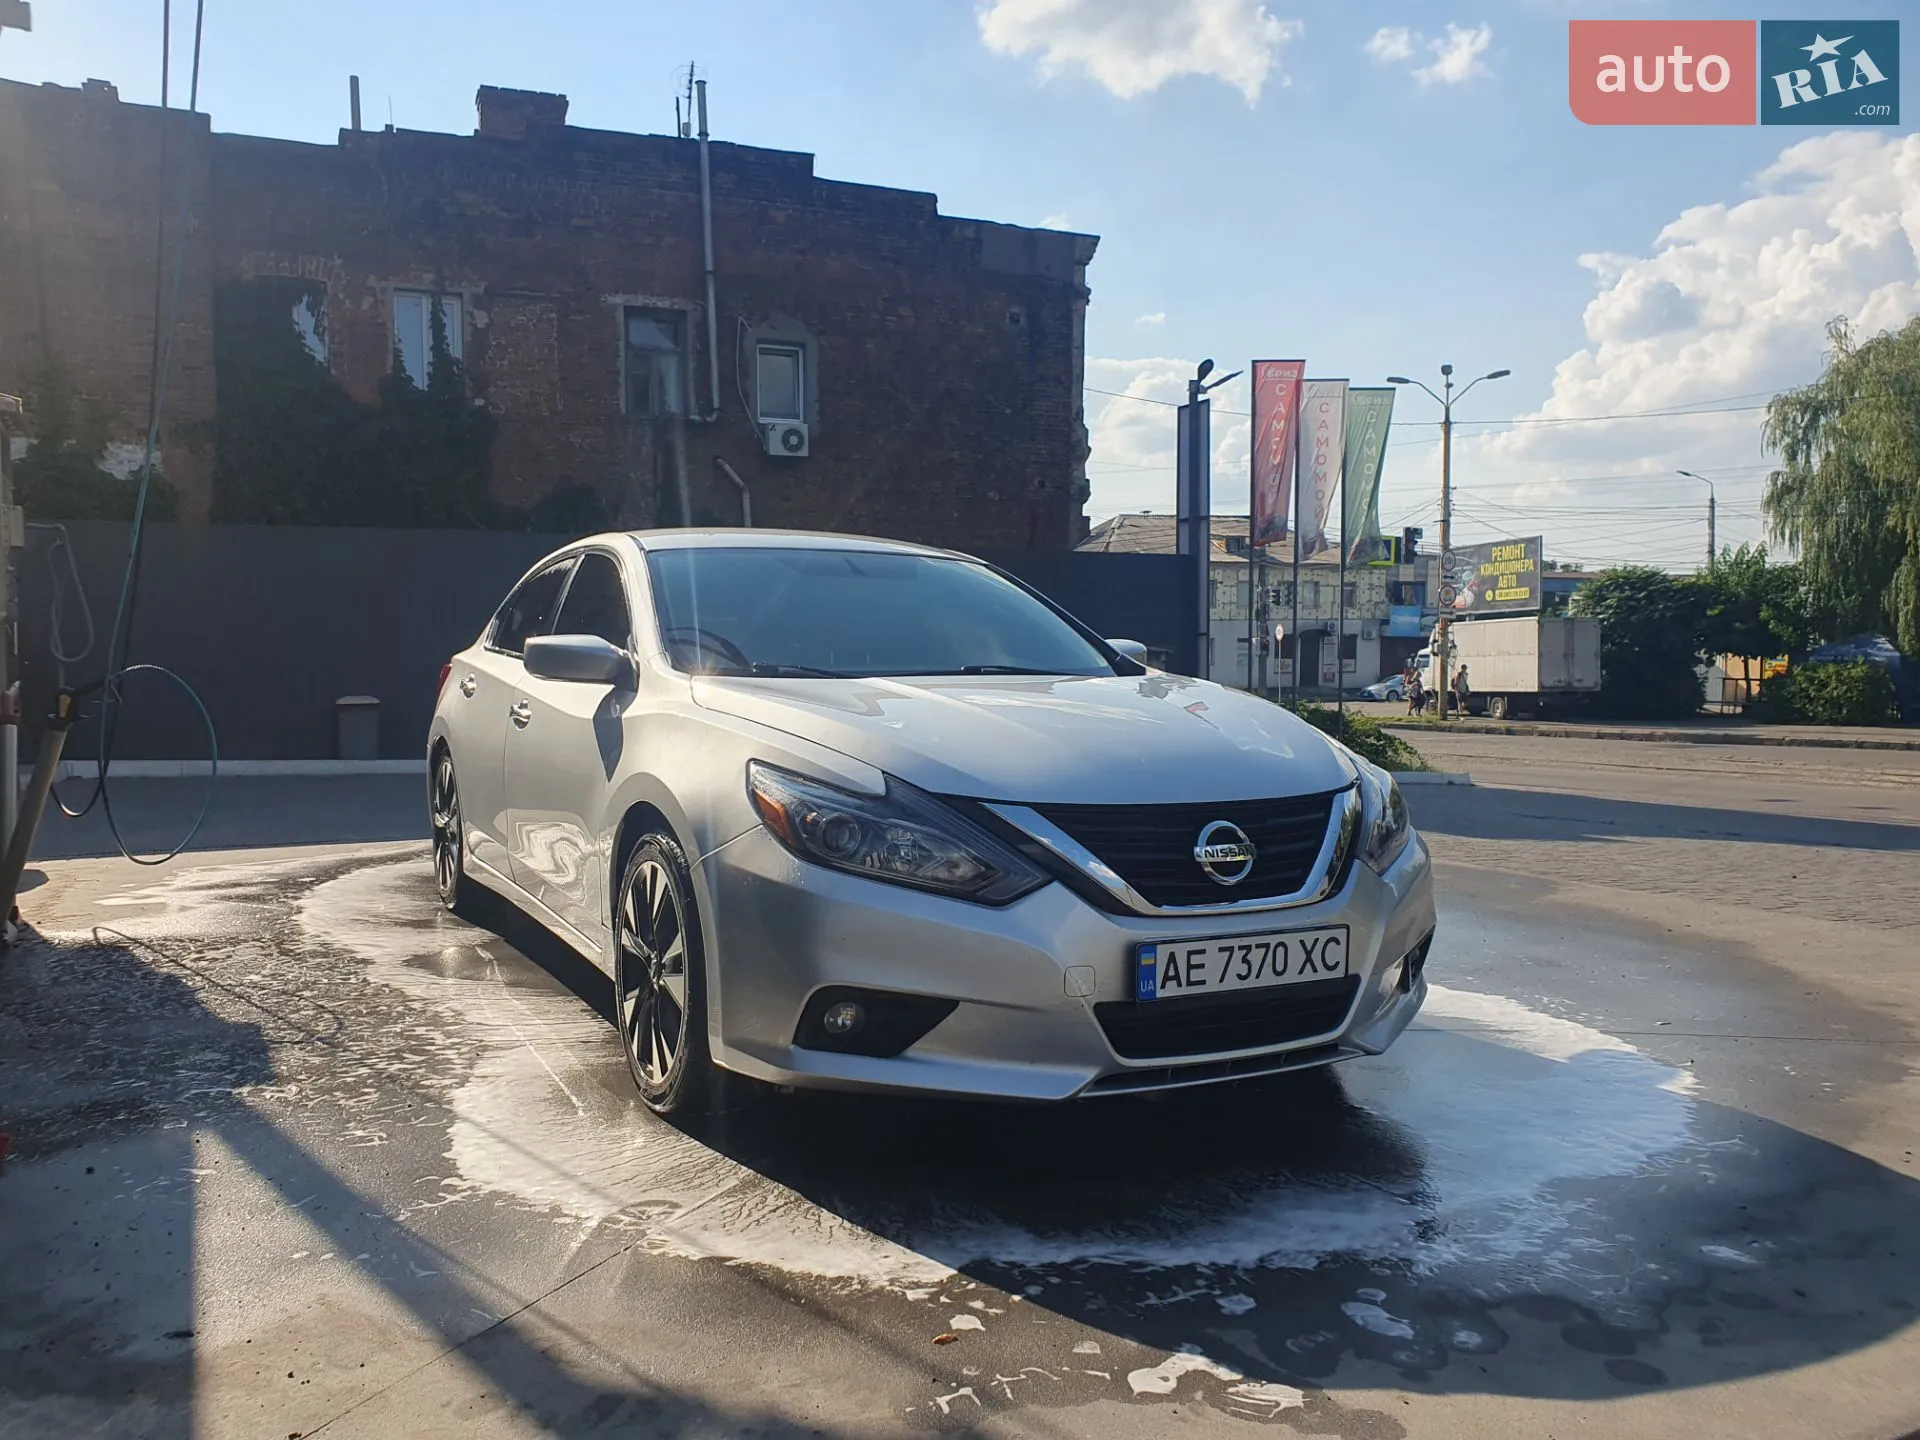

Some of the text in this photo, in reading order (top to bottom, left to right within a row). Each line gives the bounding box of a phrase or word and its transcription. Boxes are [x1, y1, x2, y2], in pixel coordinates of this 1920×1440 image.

[1361, 410, 1377, 520] САМОМО
[1492, 544, 1526, 561] РЕМОНТ
[1498, 574, 1517, 588] АВТО
[1204, 847, 1254, 859] NISSAN
[1160, 936, 1341, 989] AE 7370 XC
[1140, 979, 1155, 993] UA
